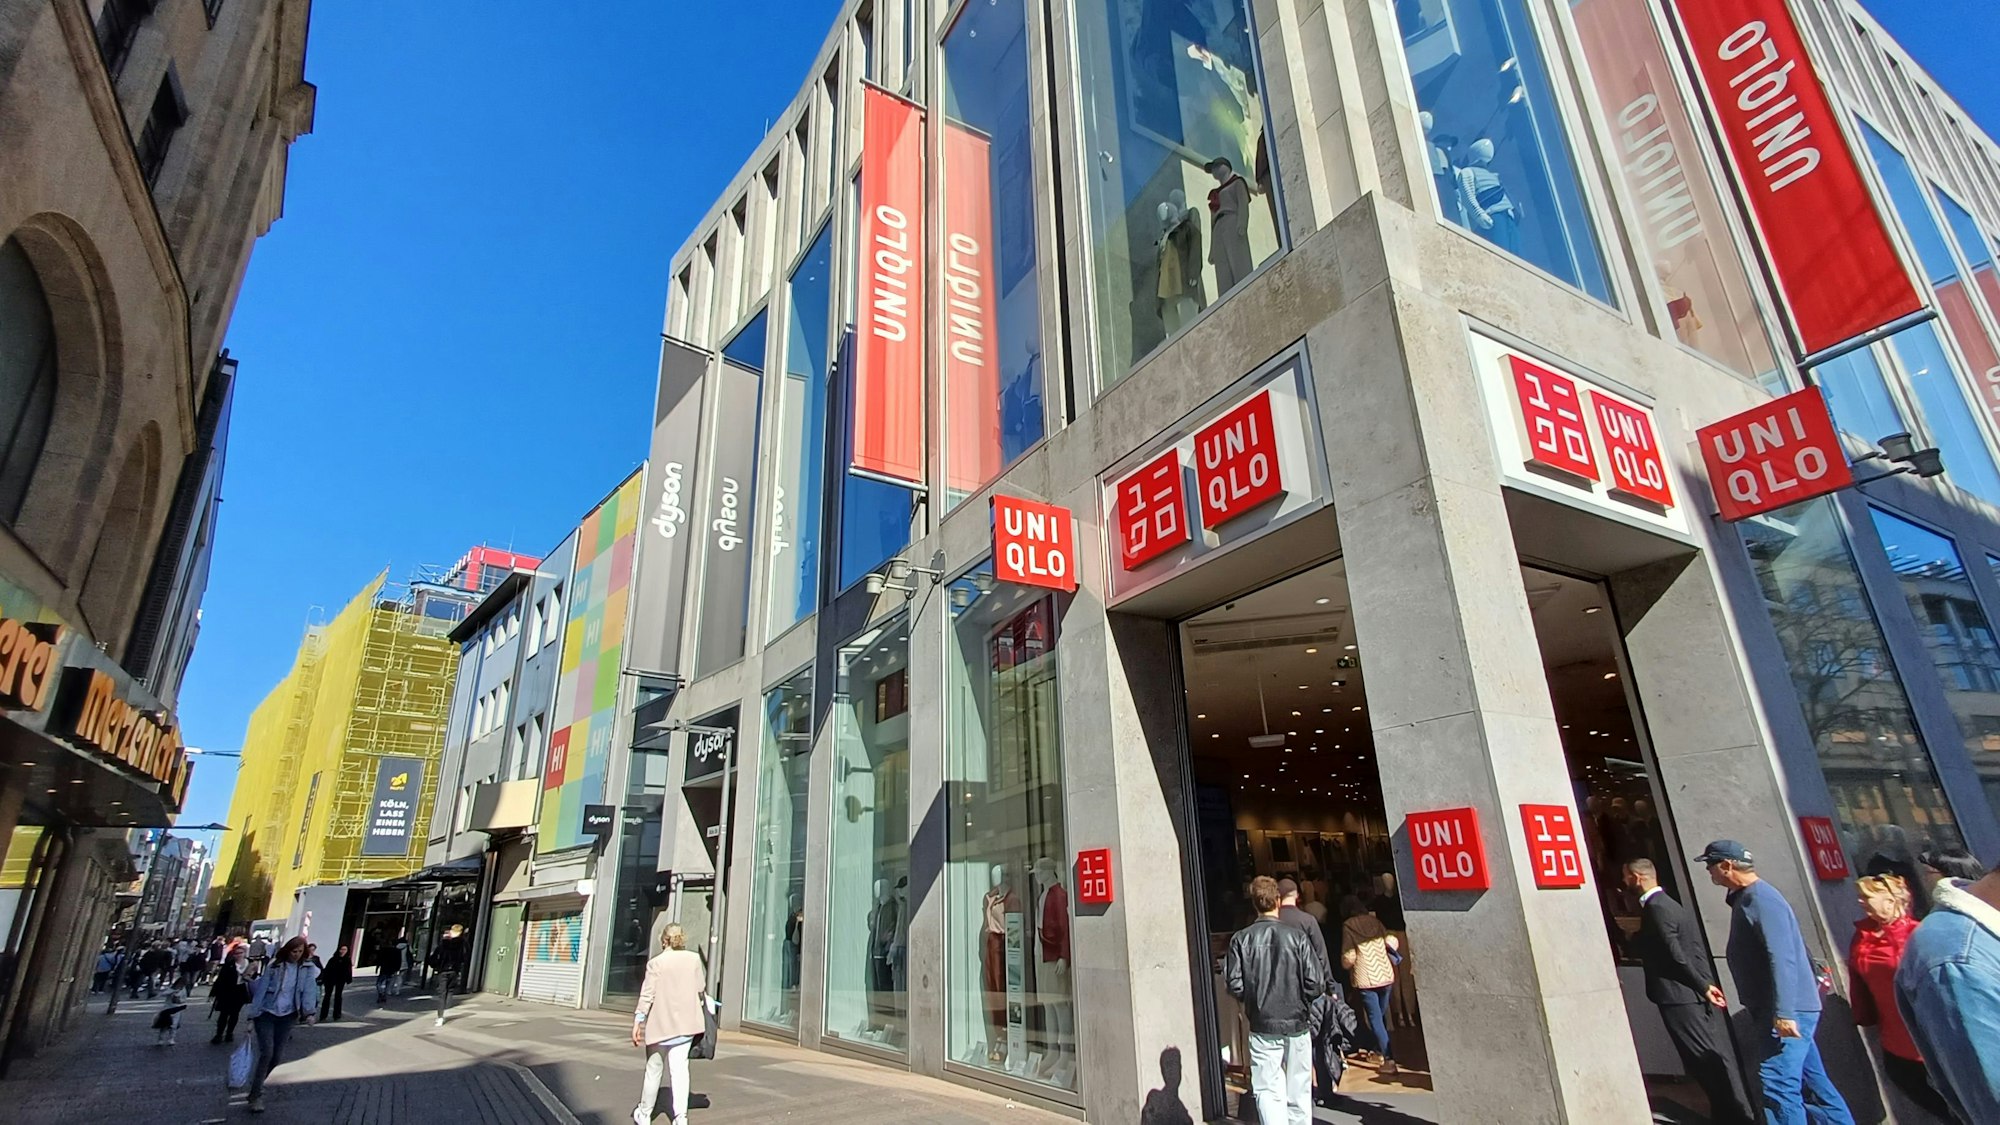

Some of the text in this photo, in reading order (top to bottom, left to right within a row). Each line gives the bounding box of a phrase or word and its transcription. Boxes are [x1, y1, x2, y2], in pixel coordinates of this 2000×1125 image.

[1717, 20, 1821, 193] UNIQLO
[873, 204, 913, 342] UNIQLO
[1203, 412, 1259, 470] UNI
[1600, 404, 1650, 452] UNI
[1712, 407, 1806, 464] UNI
[1208, 452, 1269, 513] QLO
[1613, 446, 1663, 492] QLO
[1727, 446, 1828, 505] QLO
[651, 461, 686, 539] dyson
[1003, 507, 1059, 545] UNI
[1005, 542, 1066, 578] QLO
[550, 743, 564, 774] HI
[379, 809, 405, 818] LASS
[380, 798, 410, 810] KÖLN,
[588, 815, 611, 825] dyson
[375, 818, 406, 828] EINEN
[1413, 819, 1464, 848] UNI
[1810, 823, 1834, 846] UNI
[1420, 850, 1475, 884] QLO
[1819, 849, 1844, 874] QLO
